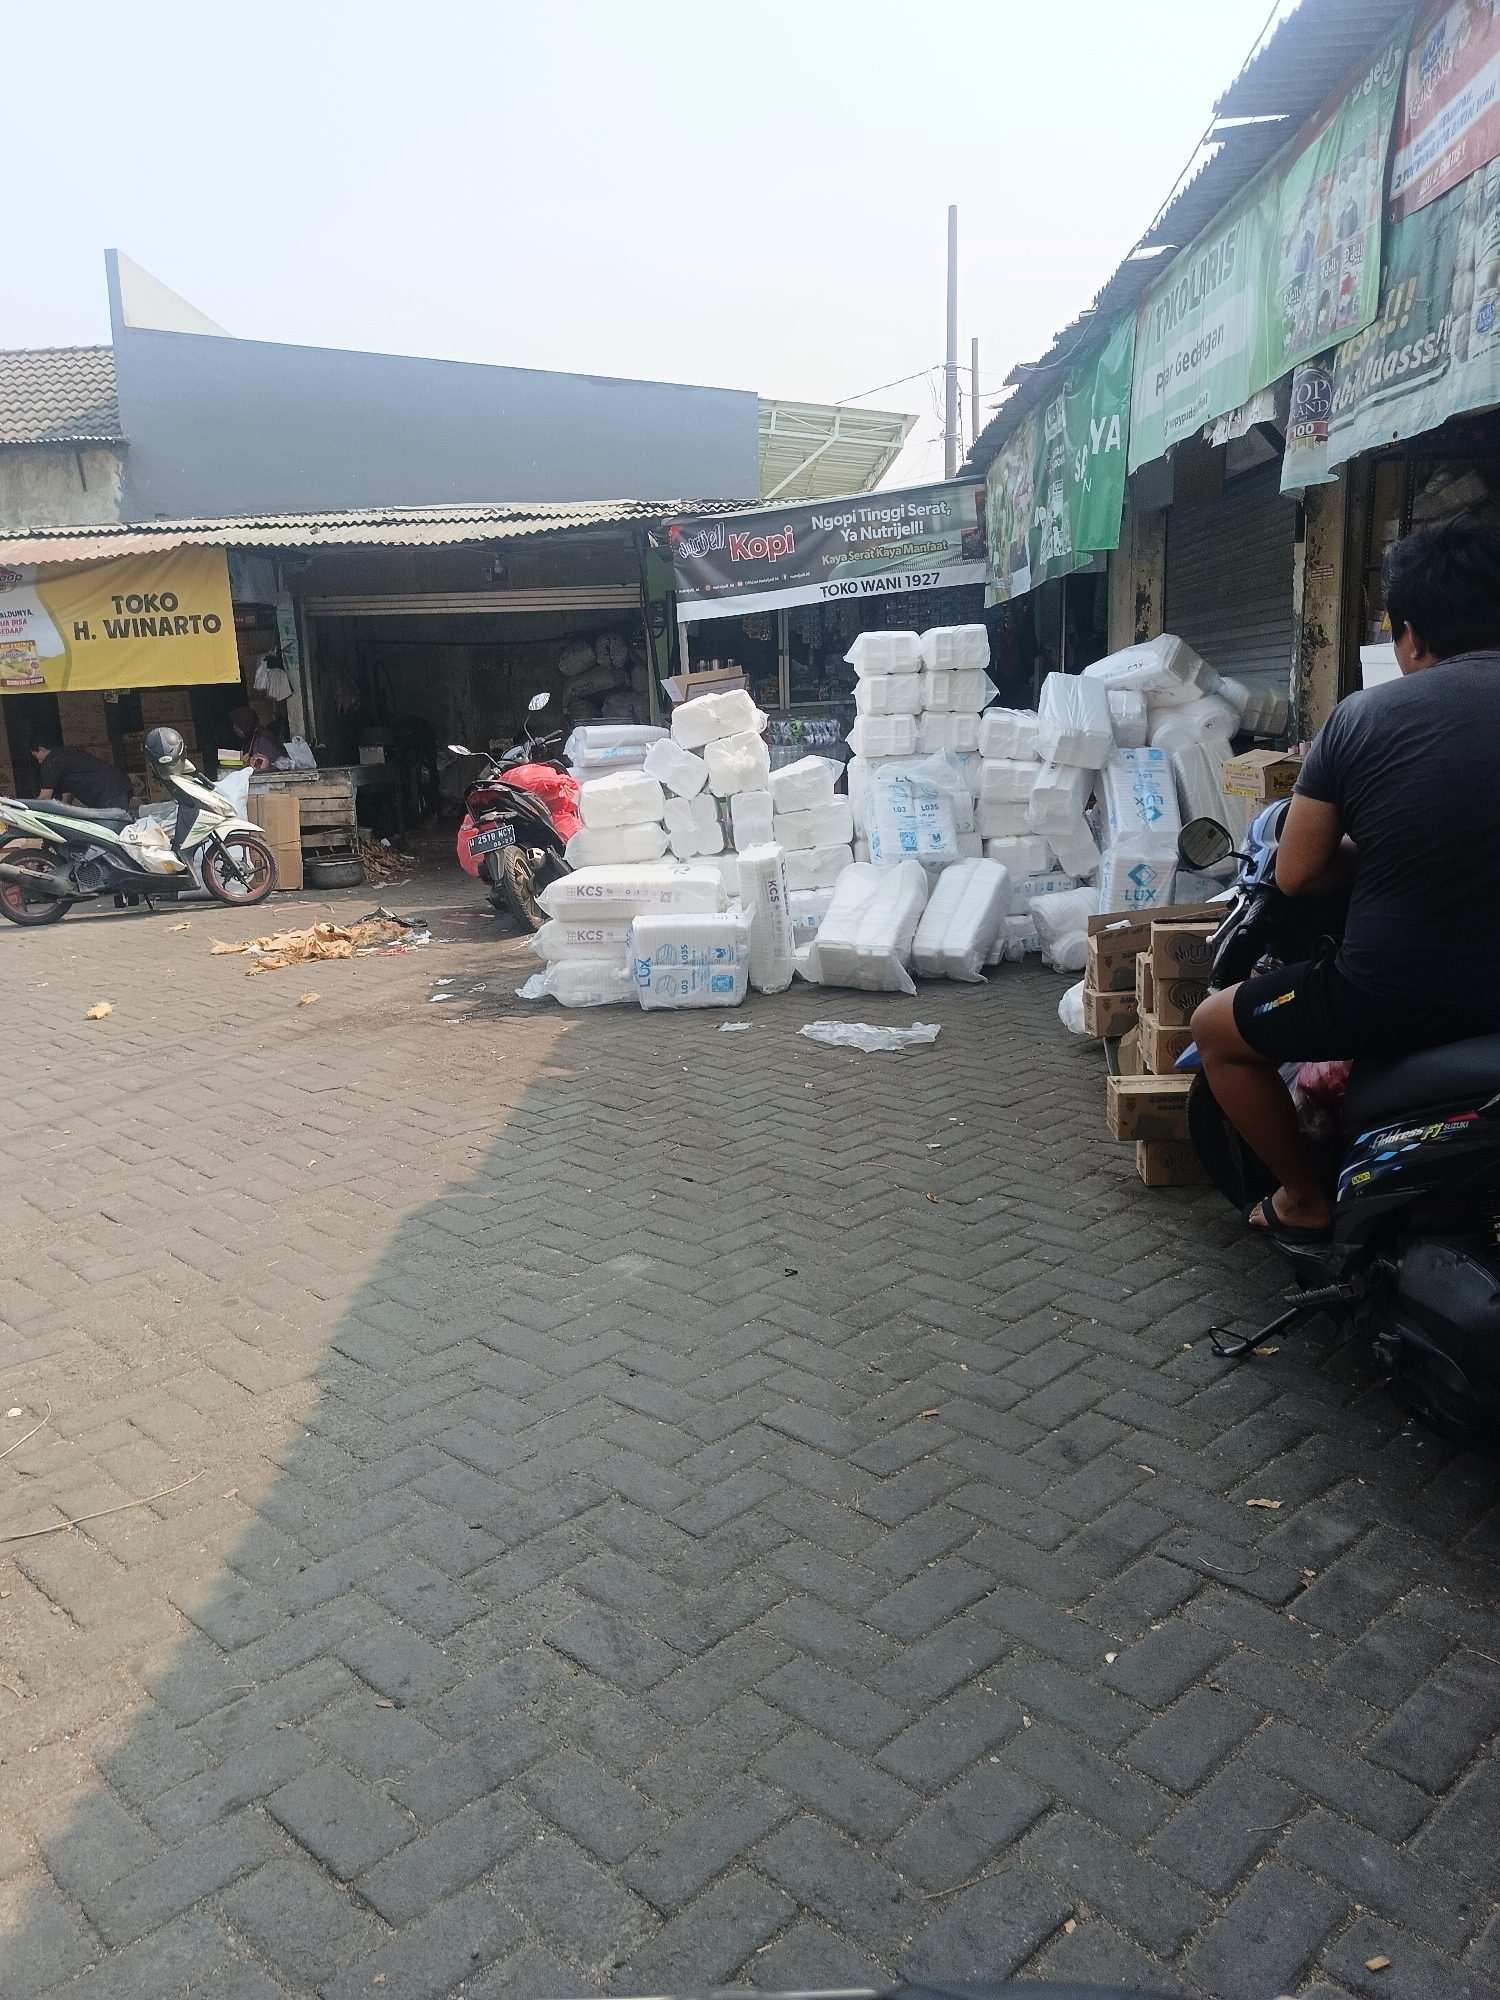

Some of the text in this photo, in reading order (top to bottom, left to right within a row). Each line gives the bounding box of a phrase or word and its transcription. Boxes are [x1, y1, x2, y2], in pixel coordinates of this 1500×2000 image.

[1296, 379, 1328, 404] OP
[1292, 423, 1315, 437] 100
[811, 501, 952, 530] Ngopi Tinggi Serat,
[841, 521, 924, 542] Ya Nutrijell!
[729, 525, 796, 563] Kopi
[822, 540, 949, 566] Kaya Serat Kaya Manfaat
[820, 572, 940, 597] TOKO WANI 1927
[111, 592, 178, 615] TOKO
[11, 618, 28, 626] BISA
[73, 613, 222, 641] H. WINARTO
[477, 832, 496, 845] 2518
[576, 885, 603, 897] KCS
[768, 880, 780, 903] KCS
[1124, 889, 1157, 902] LUX
[577, 930, 604, 941] KCS
[638, 956, 651, 988] LUX
[681, 979, 689, 995] L03
[1371, 1126, 1424, 1149] Address
[1443, 1120, 1470, 1131] SUZUKI
